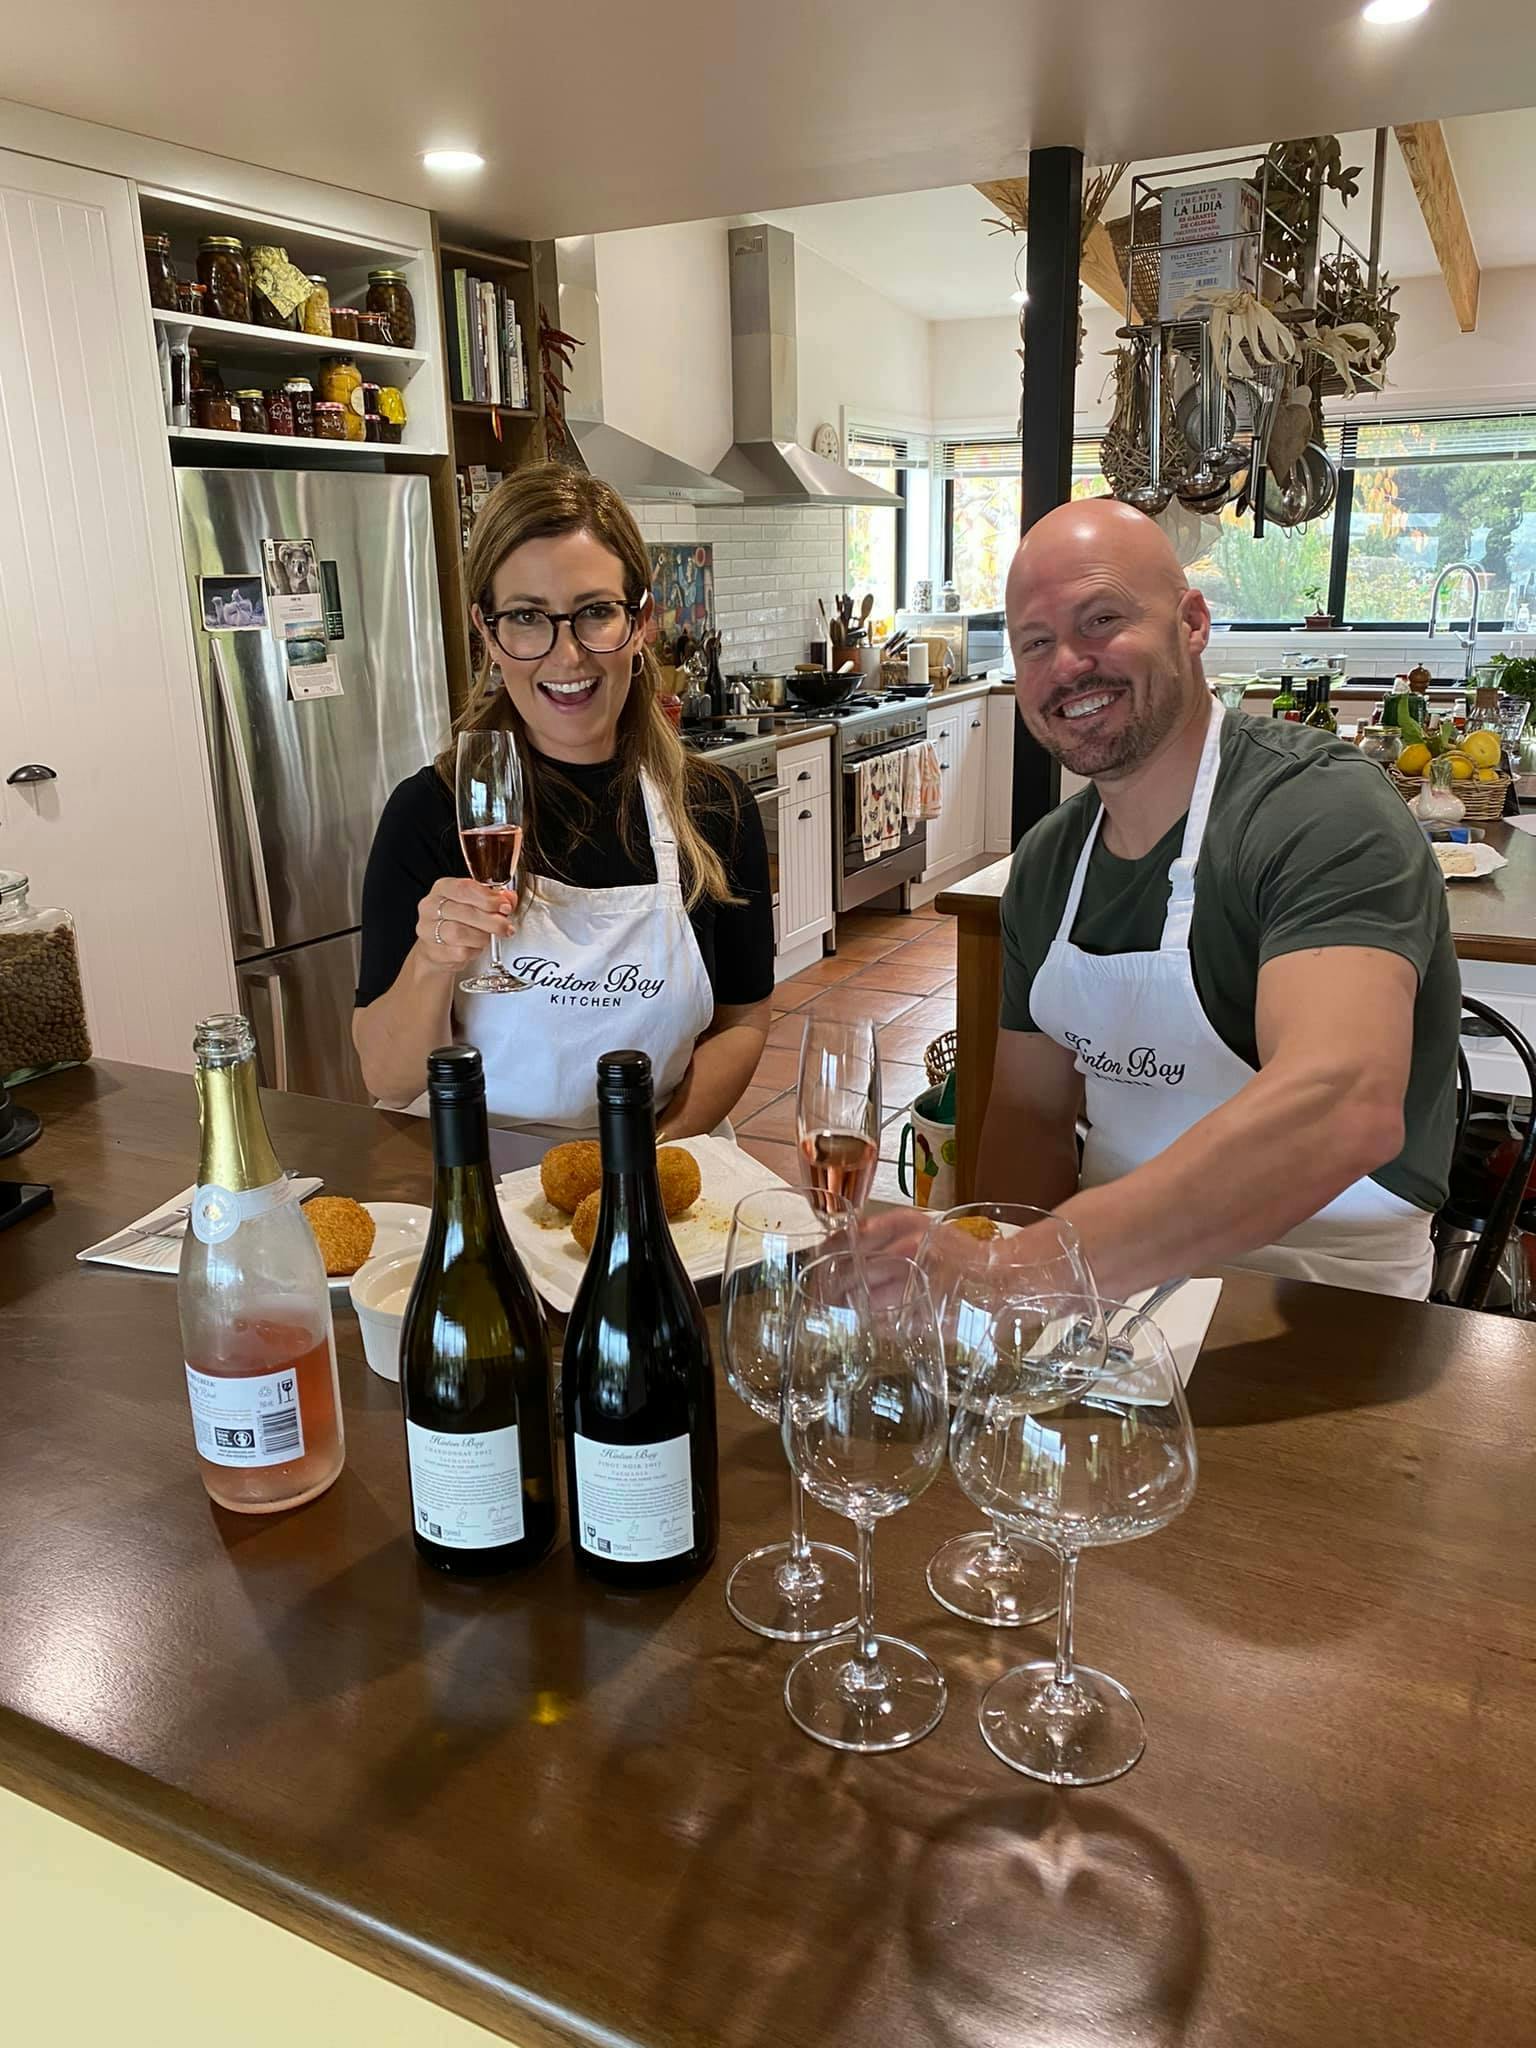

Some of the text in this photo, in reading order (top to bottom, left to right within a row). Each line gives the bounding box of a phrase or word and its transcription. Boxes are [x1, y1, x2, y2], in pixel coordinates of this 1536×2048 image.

[1173, 200, 1223, 217] LA LIDIA
[512, 956, 665, 999] Hinton Bay
[550, 994, 622, 1007] KITCHEN
[1126, 1047, 1186, 1086] Bay
[598, 1460, 620, 1469] PINOT
